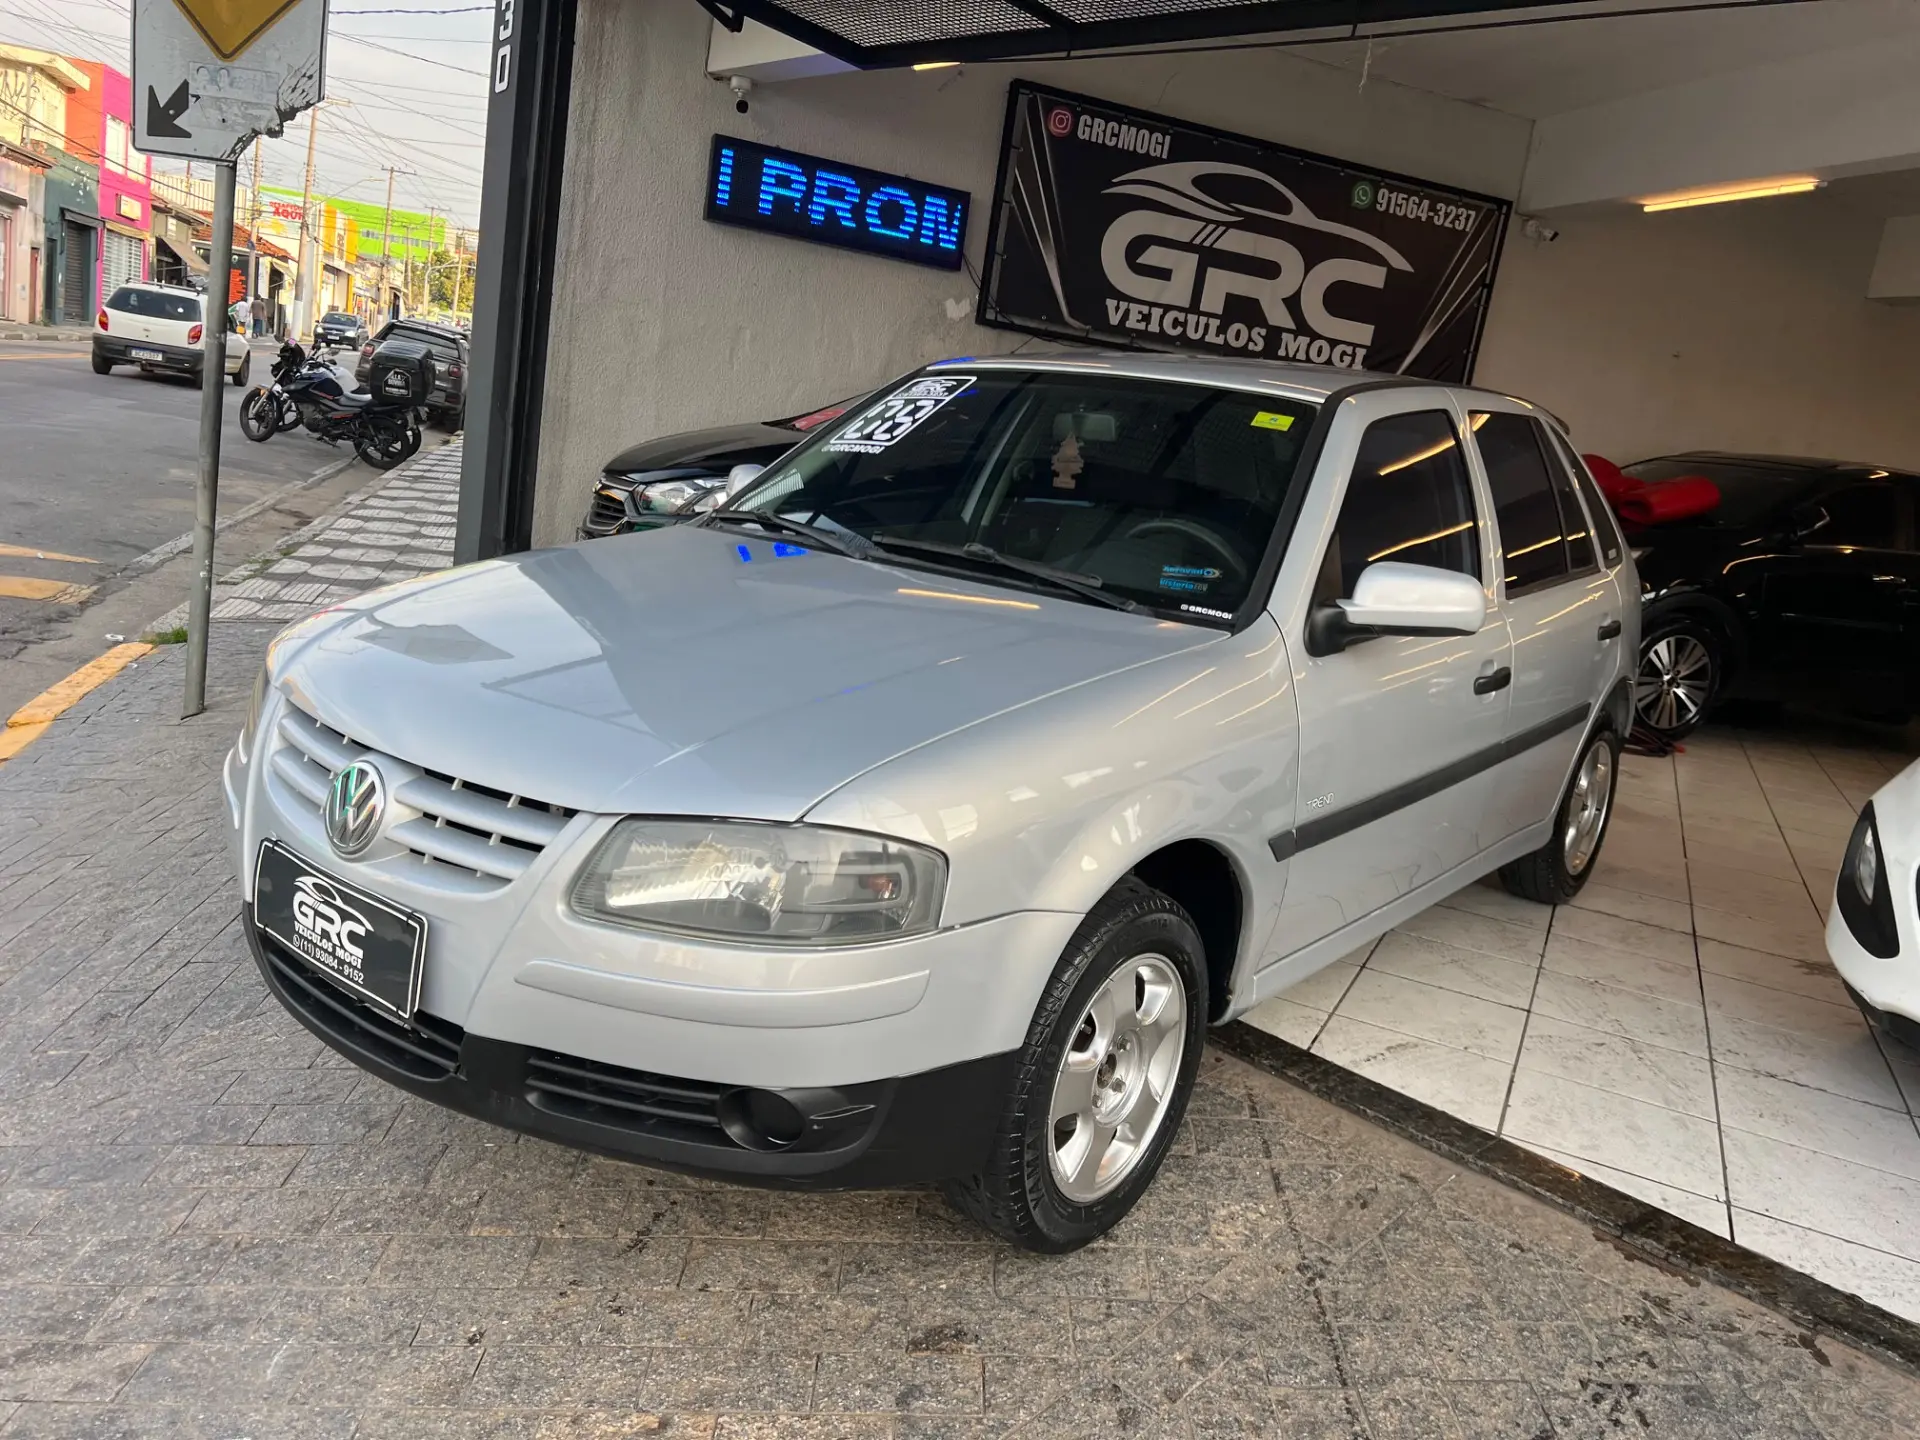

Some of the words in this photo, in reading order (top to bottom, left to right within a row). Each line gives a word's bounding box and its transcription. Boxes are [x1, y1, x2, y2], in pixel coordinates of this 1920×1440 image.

[1077, 114, 1172, 159] GRCMOGI
[1376, 188, 1476, 232] 91564-3237
[1100, 209, 1388, 346] GRC
[1105, 298, 1267, 352] VEICULOS
[1277, 332, 1367, 371] MOGI
[1306, 792, 1335, 810] TREND
[293, 891, 366, 960] GRC
[294, 920, 333, 953] VEICULOS
[336, 946, 362, 969] MOGI
[300, 939, 314, 957] (11)
[344, 965, 364, 984] 9152
